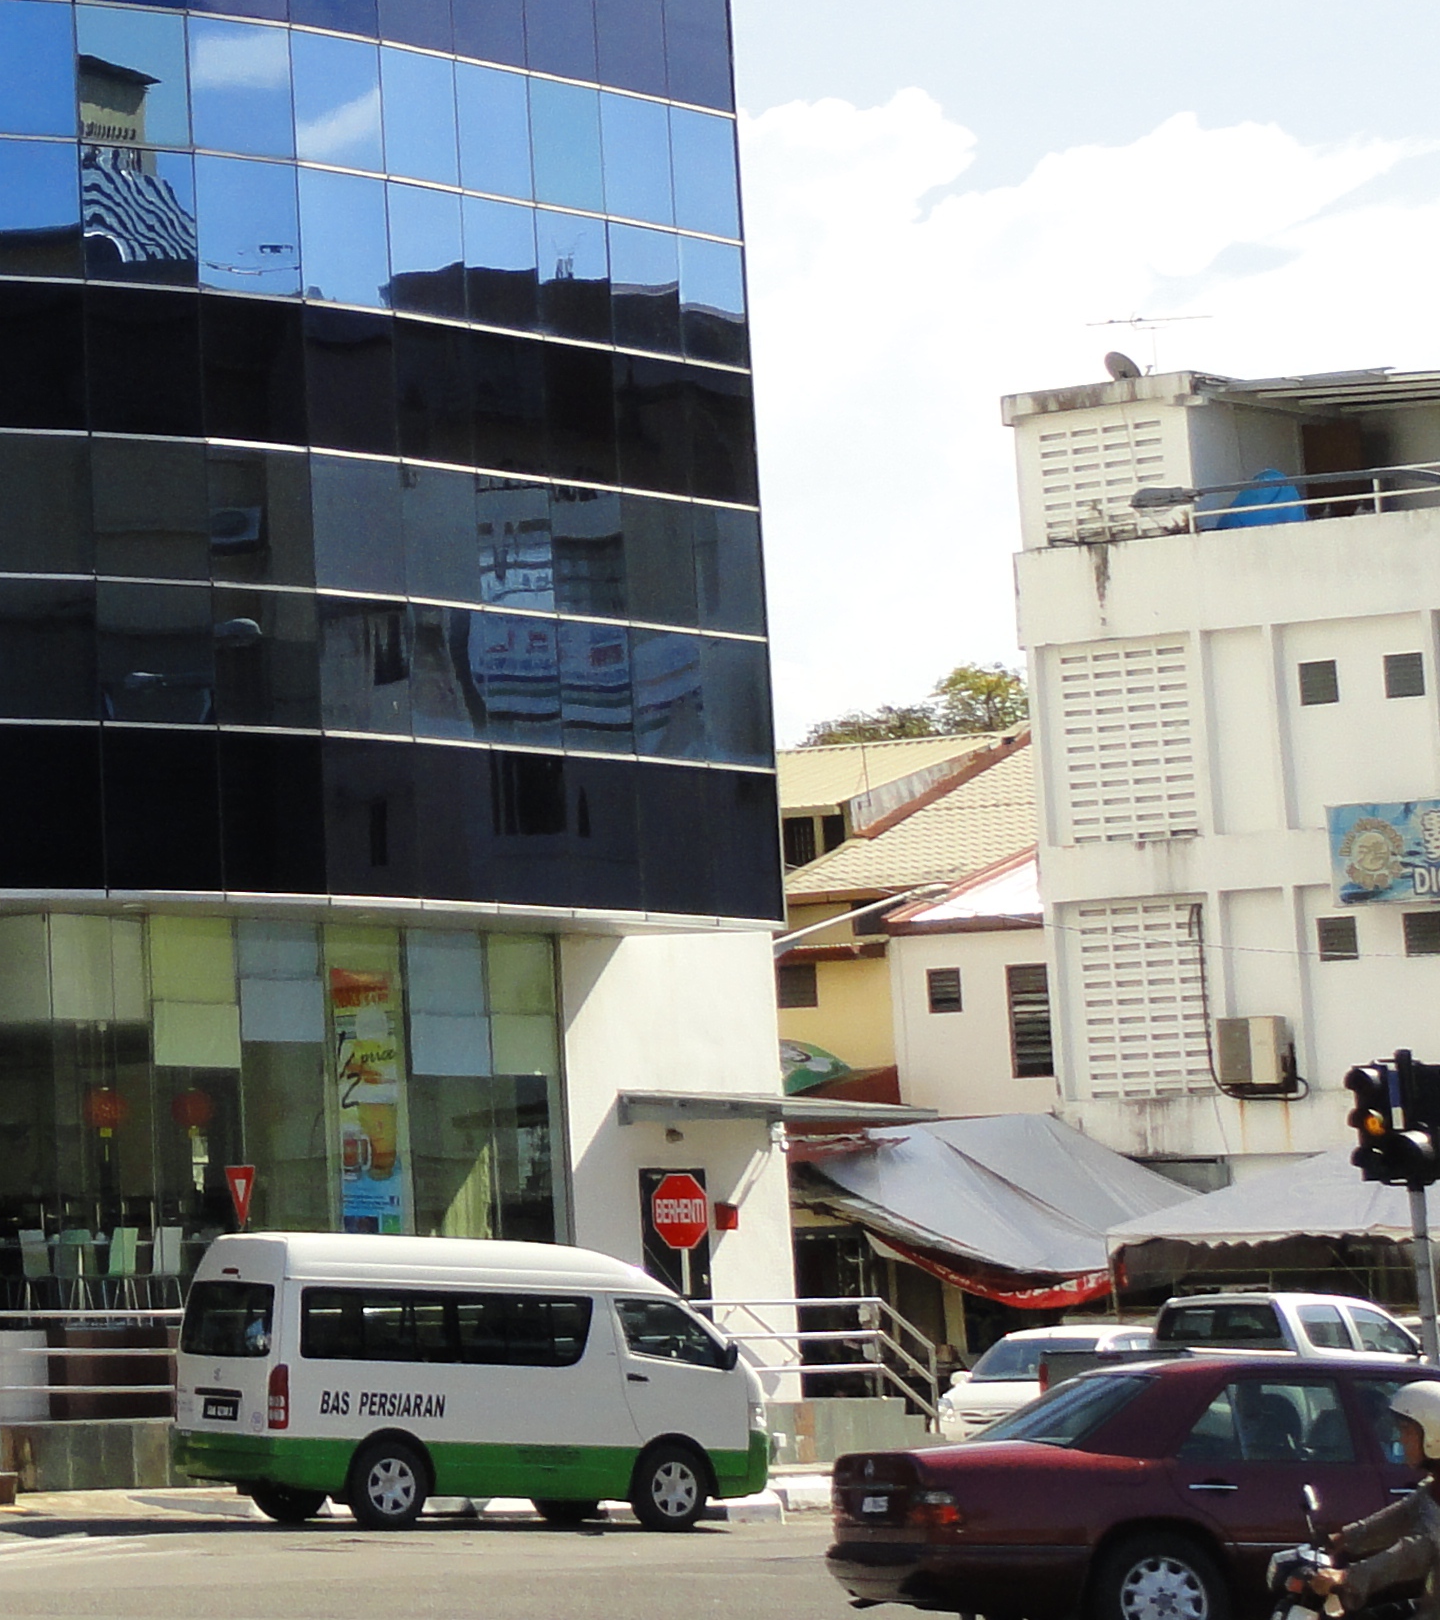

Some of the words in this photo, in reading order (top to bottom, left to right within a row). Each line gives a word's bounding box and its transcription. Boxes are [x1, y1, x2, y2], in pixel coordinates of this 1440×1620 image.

[655, 1198, 706, 1224] BERHENTI
[320, 1390, 351, 1416] BAS
[359, 1391, 447, 1418] PERSIARAN
